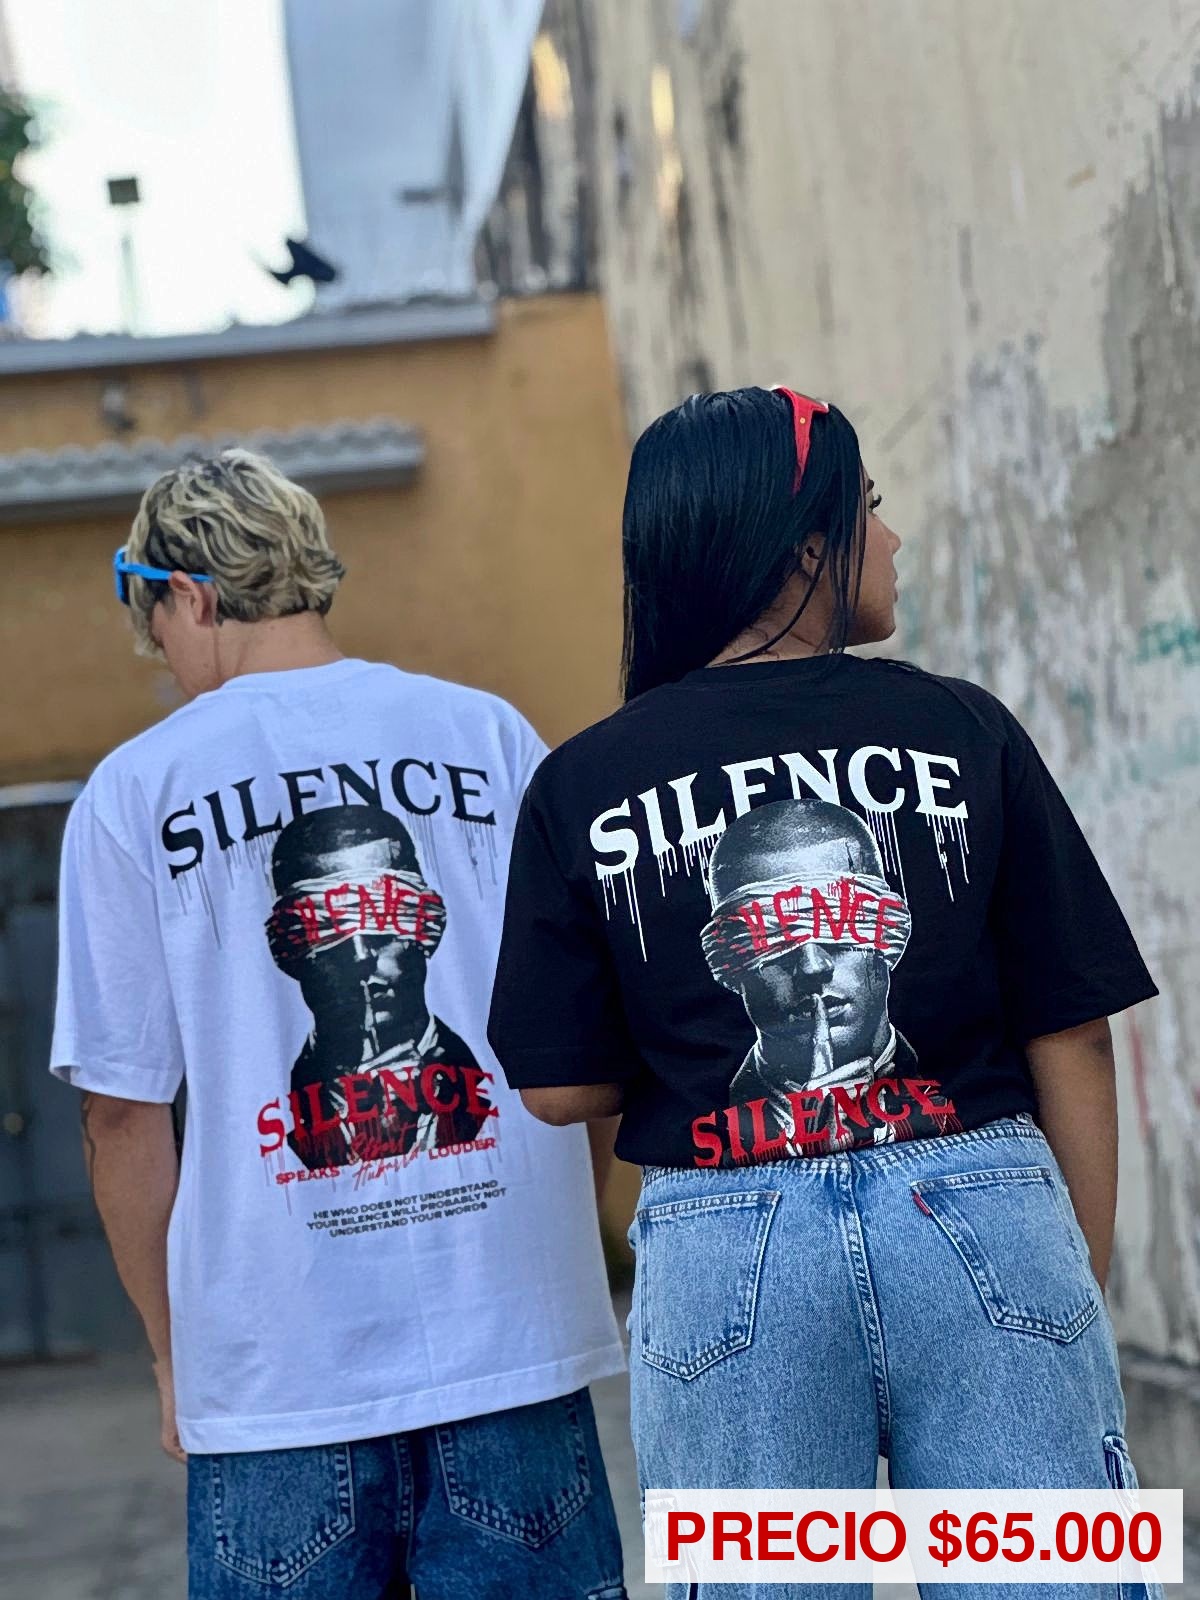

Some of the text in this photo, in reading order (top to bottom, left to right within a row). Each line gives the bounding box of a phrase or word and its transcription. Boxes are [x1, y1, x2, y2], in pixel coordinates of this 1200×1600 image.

[162, 758, 497, 880] SILENCE
[590, 745, 969, 880] SILENCE
[257, 1063, 499, 1158] SILENCE
[691, 1078, 956, 1168] SILENCE
[275, 1137, 497, 1185] SPEAKS LOUDER
[306, 1187, 507, 1231] YOUR SILENCE WILL PROBABLY NOT
[313, 1179, 498, 1220] HE WHO DOES NOT UNDERSTAND
[329, 1201, 488, 1238] UNDERSTAND YOUR WORDS
